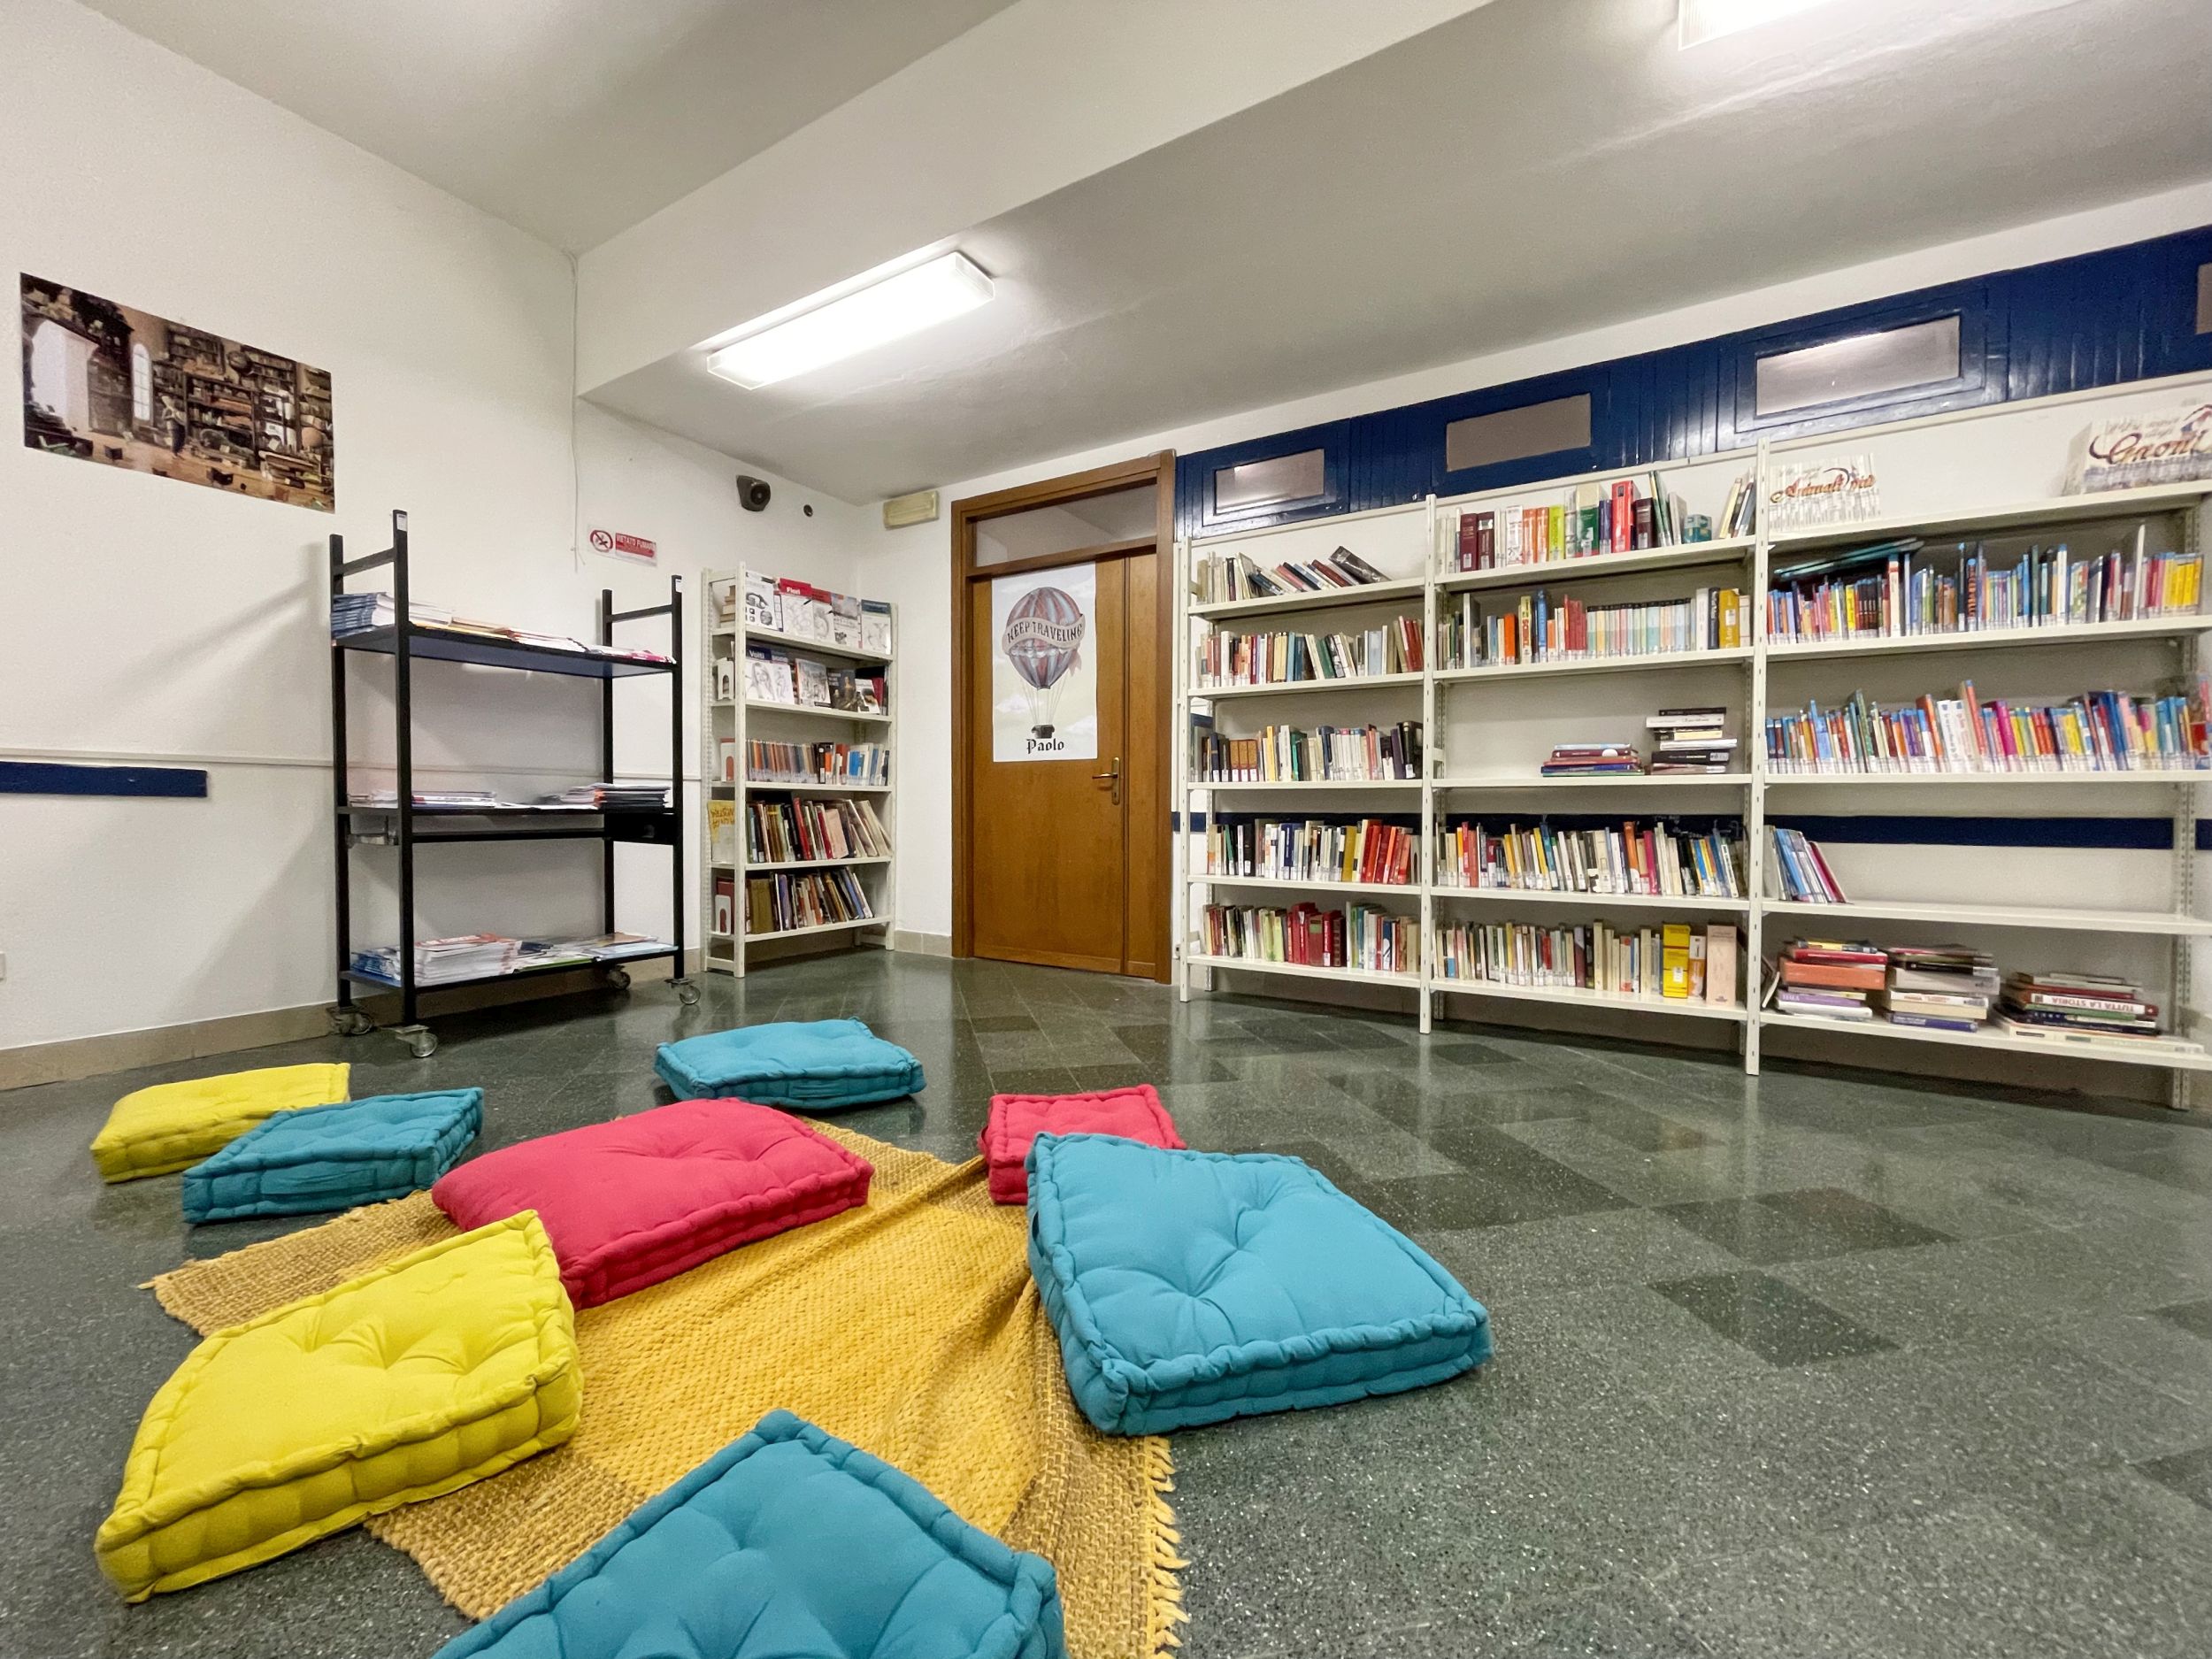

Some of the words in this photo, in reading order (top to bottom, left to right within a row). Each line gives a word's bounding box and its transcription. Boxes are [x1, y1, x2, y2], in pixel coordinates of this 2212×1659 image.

[617, 534, 636, 546] VIETATO
[1007, 621, 1030, 643] KEEP
[1032, 621, 1083, 642] TRAVELING
[1026, 738, 1064, 754] Paolo
[2052, 996, 2087, 1008] STORIA
[2102, 1002, 2134, 1013] TUTTA
